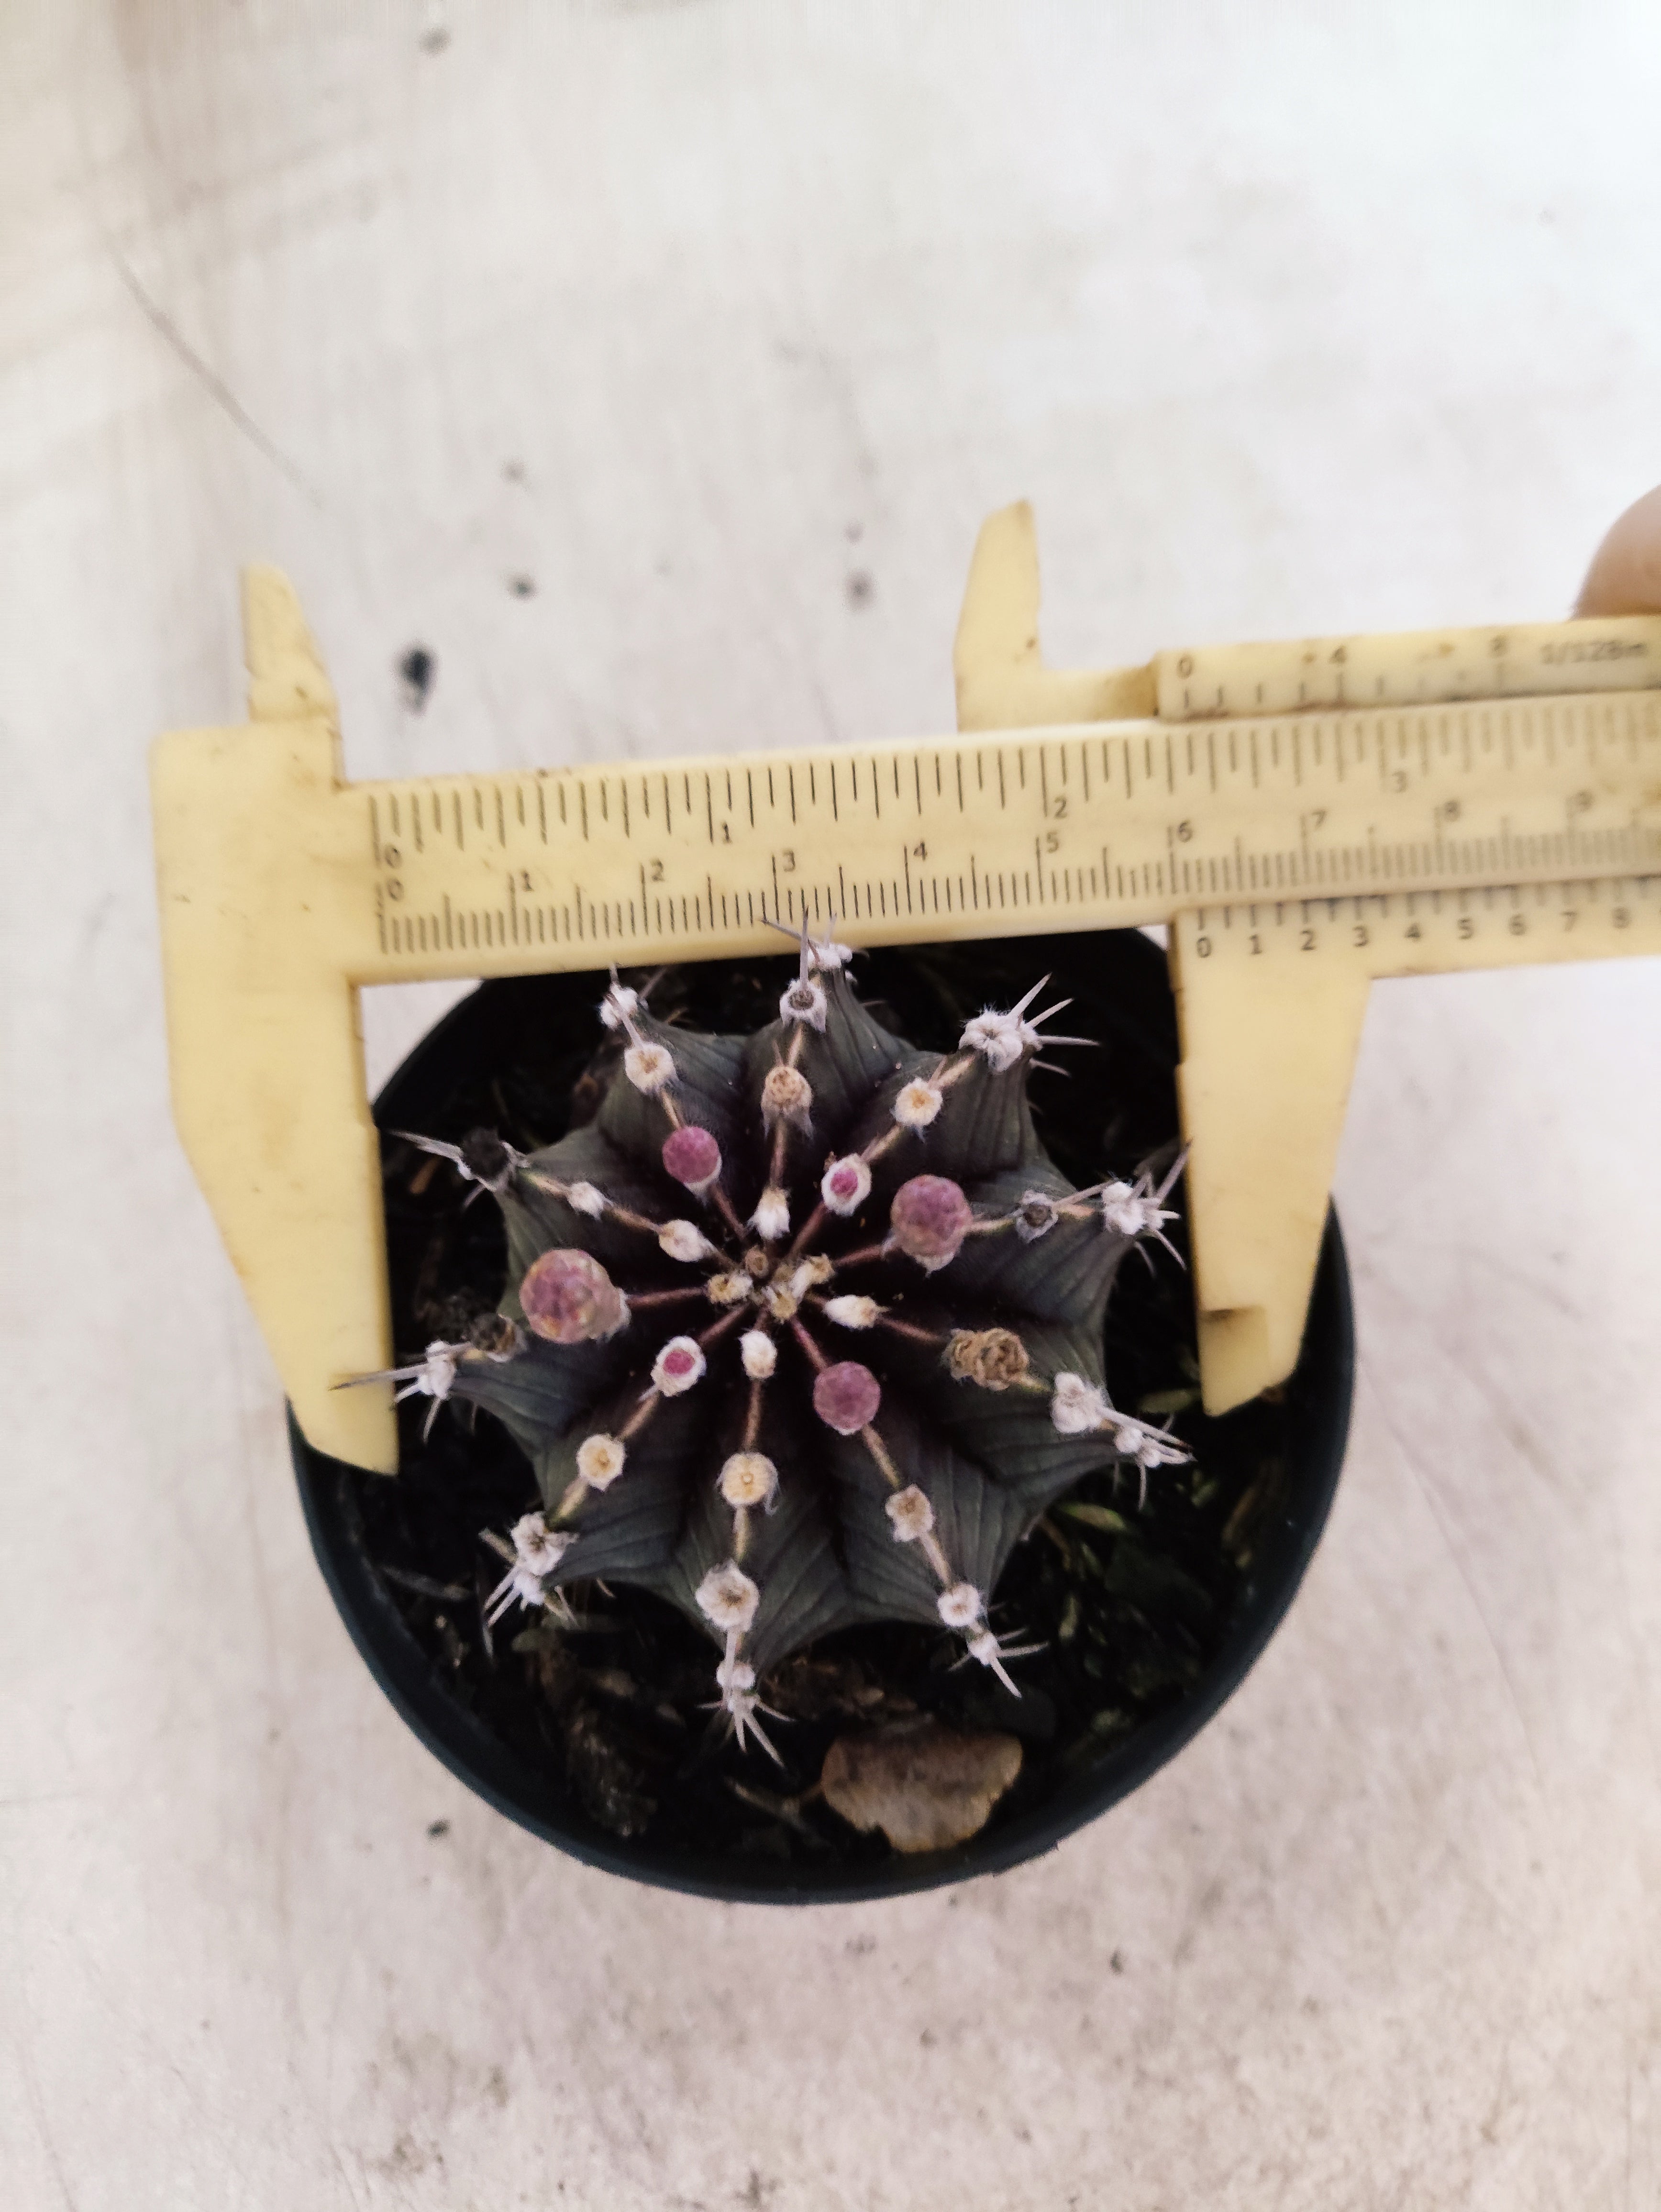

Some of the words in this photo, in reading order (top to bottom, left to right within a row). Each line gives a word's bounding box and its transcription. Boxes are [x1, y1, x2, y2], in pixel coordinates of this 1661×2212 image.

[1177, 654, 1194, 679] 0
[385, 843, 403, 868] 0
[722, 821, 731, 843] 1
[1053, 796, 1068, 819] 2
[1392, 772, 1408, 793] 3
[387, 878, 405, 902] 0
[521, 871, 533, 892] 1
[651, 859, 664, 881] 2
[783, 850, 796, 872] 3
[913, 841, 928, 861] 4
[1046, 832, 1060, 853] 5
[1177, 821, 1193, 842] 6
[1312, 810, 1328, 829] 7
[1196, 937, 1212, 958] 0
[1250, 934, 1263, 956] 1
[1301, 930, 1317, 951] 2
[1353, 926, 1369, 948] 3
[1405, 922, 1422, 942] 4
[1458, 918, 1474, 940] 5
[1508, 914, 1525, 936] 6
[1561, 911, 1578, 932] 7
